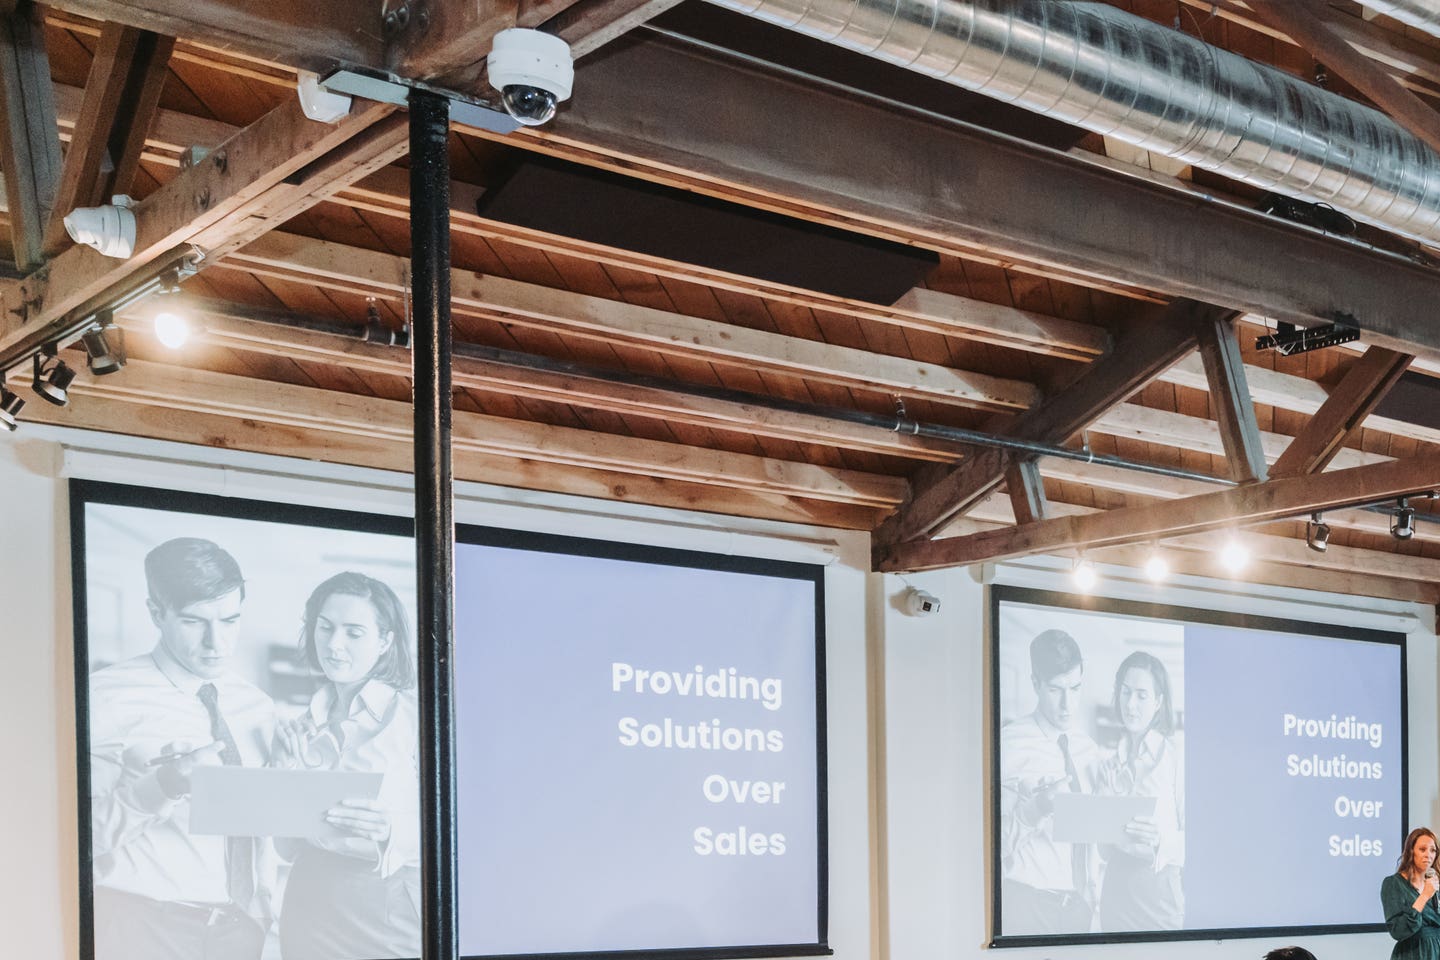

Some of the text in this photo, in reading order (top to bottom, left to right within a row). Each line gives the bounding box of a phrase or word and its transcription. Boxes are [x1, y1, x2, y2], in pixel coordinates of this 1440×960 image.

[611, 662, 783, 711] Providing
[617, 716, 784, 752] Solutions
[1283, 713, 1383, 749] Providing
[1287, 753, 1383, 779] Solutions
[702, 774, 786, 804] Over
[1334, 795, 1384, 818] Over
[693, 825, 787, 856] Sales
[1328, 833, 1383, 857] Sales
